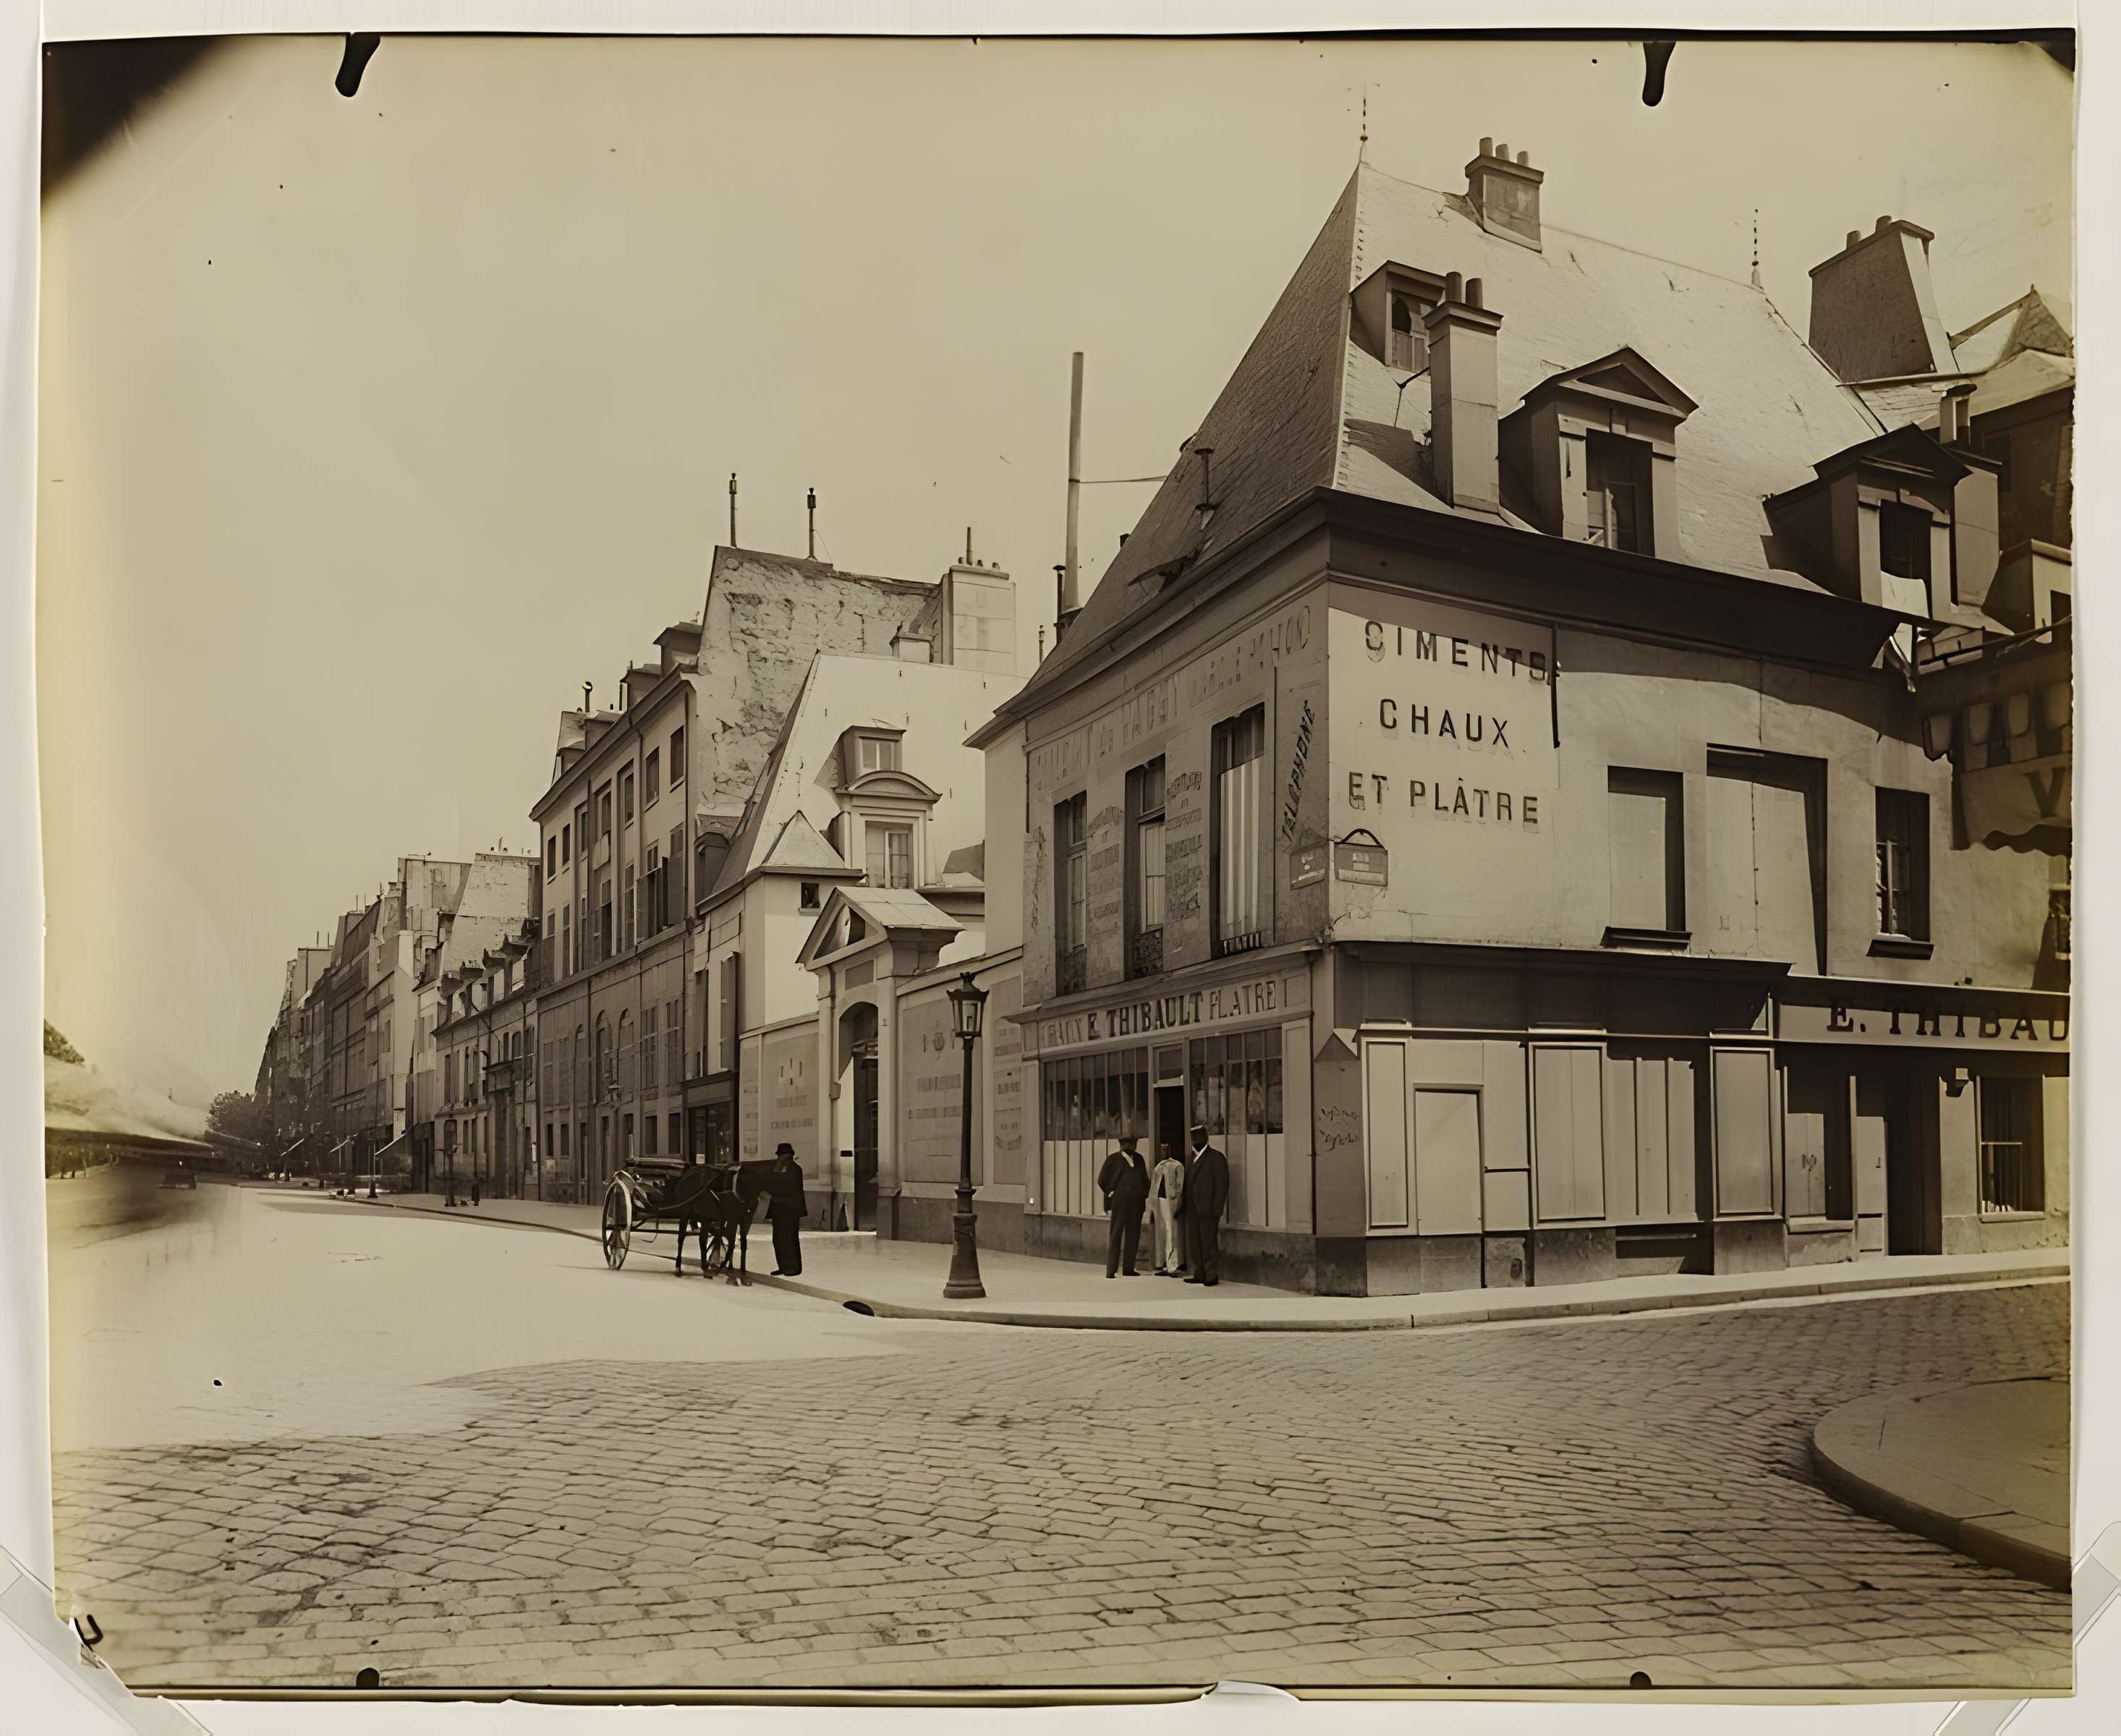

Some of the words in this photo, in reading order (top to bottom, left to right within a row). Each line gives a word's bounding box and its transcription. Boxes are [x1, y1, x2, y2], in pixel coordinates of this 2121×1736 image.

[1380, 698, 1509, 749] CHAUX
[1348, 771, 1388, 810] ET
[1410, 778, 1539, 824] PLÂTRE
[1107, 990, 1203, 1037] THIBAULT
